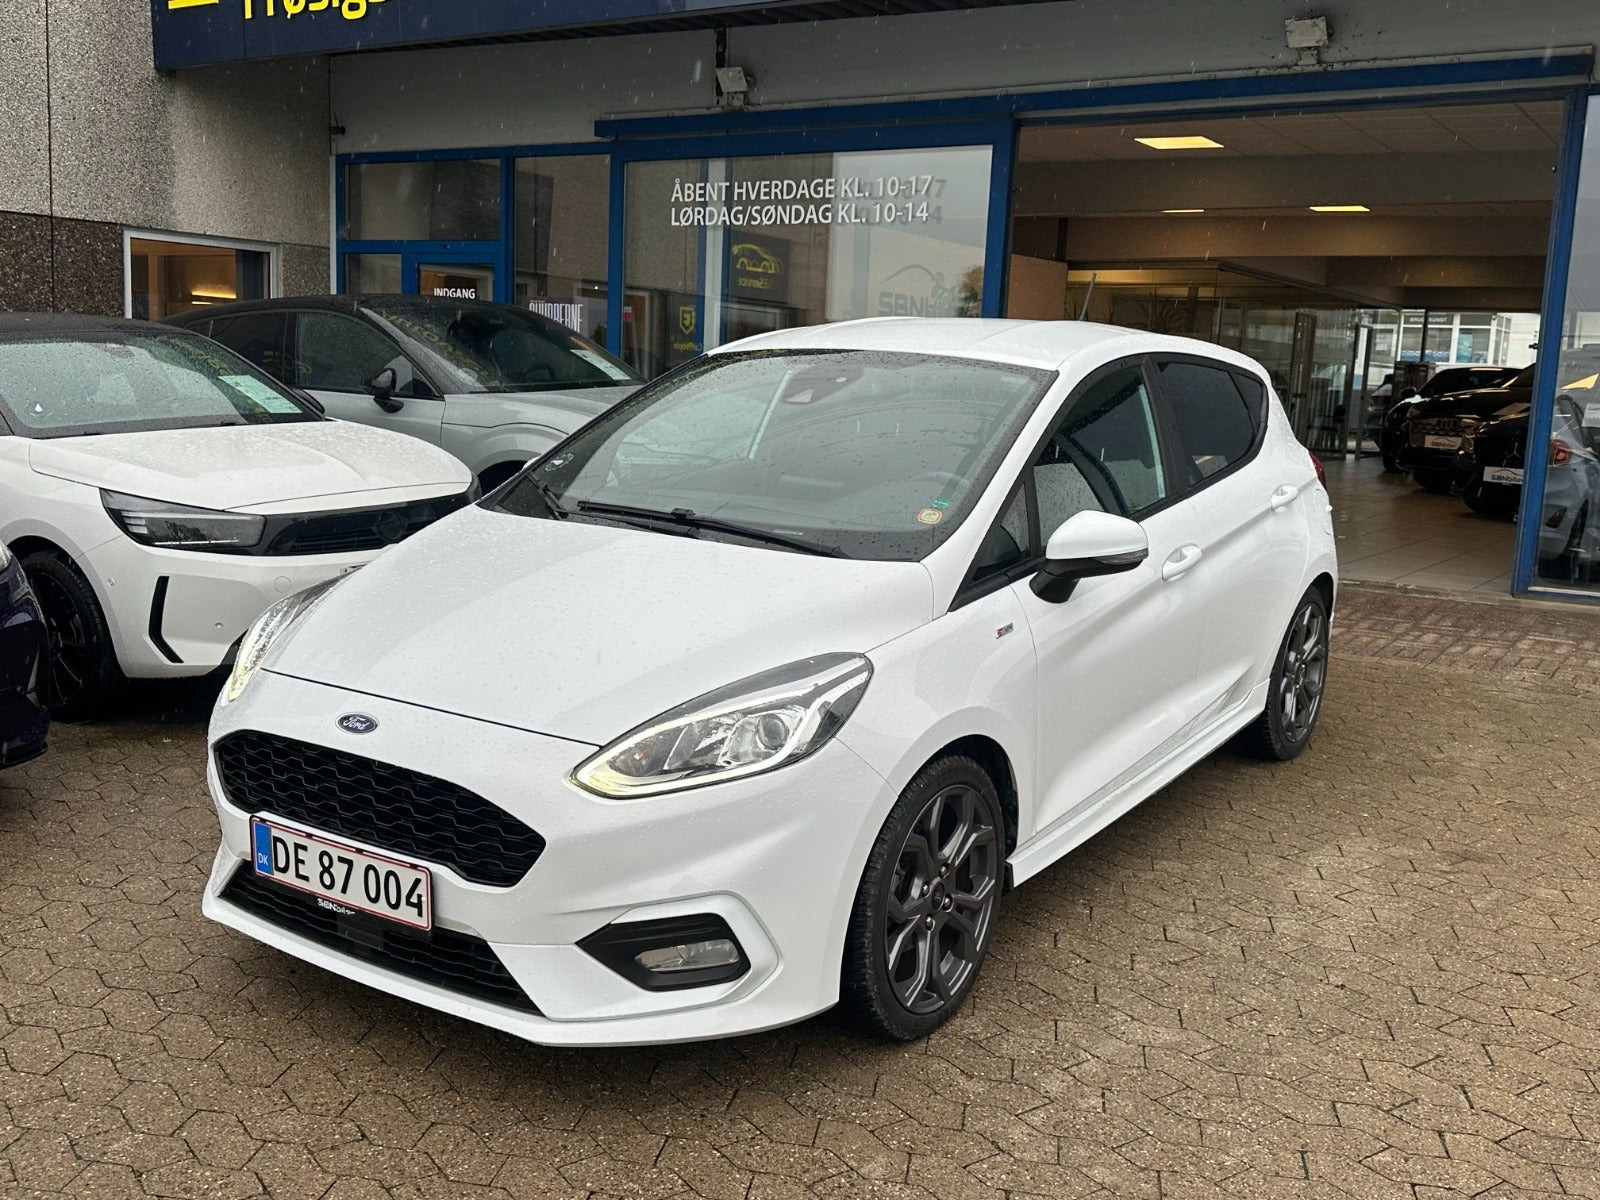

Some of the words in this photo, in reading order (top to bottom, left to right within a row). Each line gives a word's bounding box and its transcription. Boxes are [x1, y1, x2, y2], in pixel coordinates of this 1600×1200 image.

[671, 178, 730, 202] ÅBENT
[734, 179, 836, 201] HVERDAGE
[841, 177, 870, 198] KL.
[877, 175, 933, 196] 10-17
[671, 203, 832, 227] LØRDAG/SØNDAG
[838, 203, 866, 224] KL.
[873, 201, 929, 223] 10-14
[433, 287, 476, 299] INDGANG
[343, 716, 370, 730] Ford
[258, 852, 269, 866] DK
[272, 835, 310, 883] DE
[318, 850, 354, 895] 87
[363, 864, 424, 918] 004
